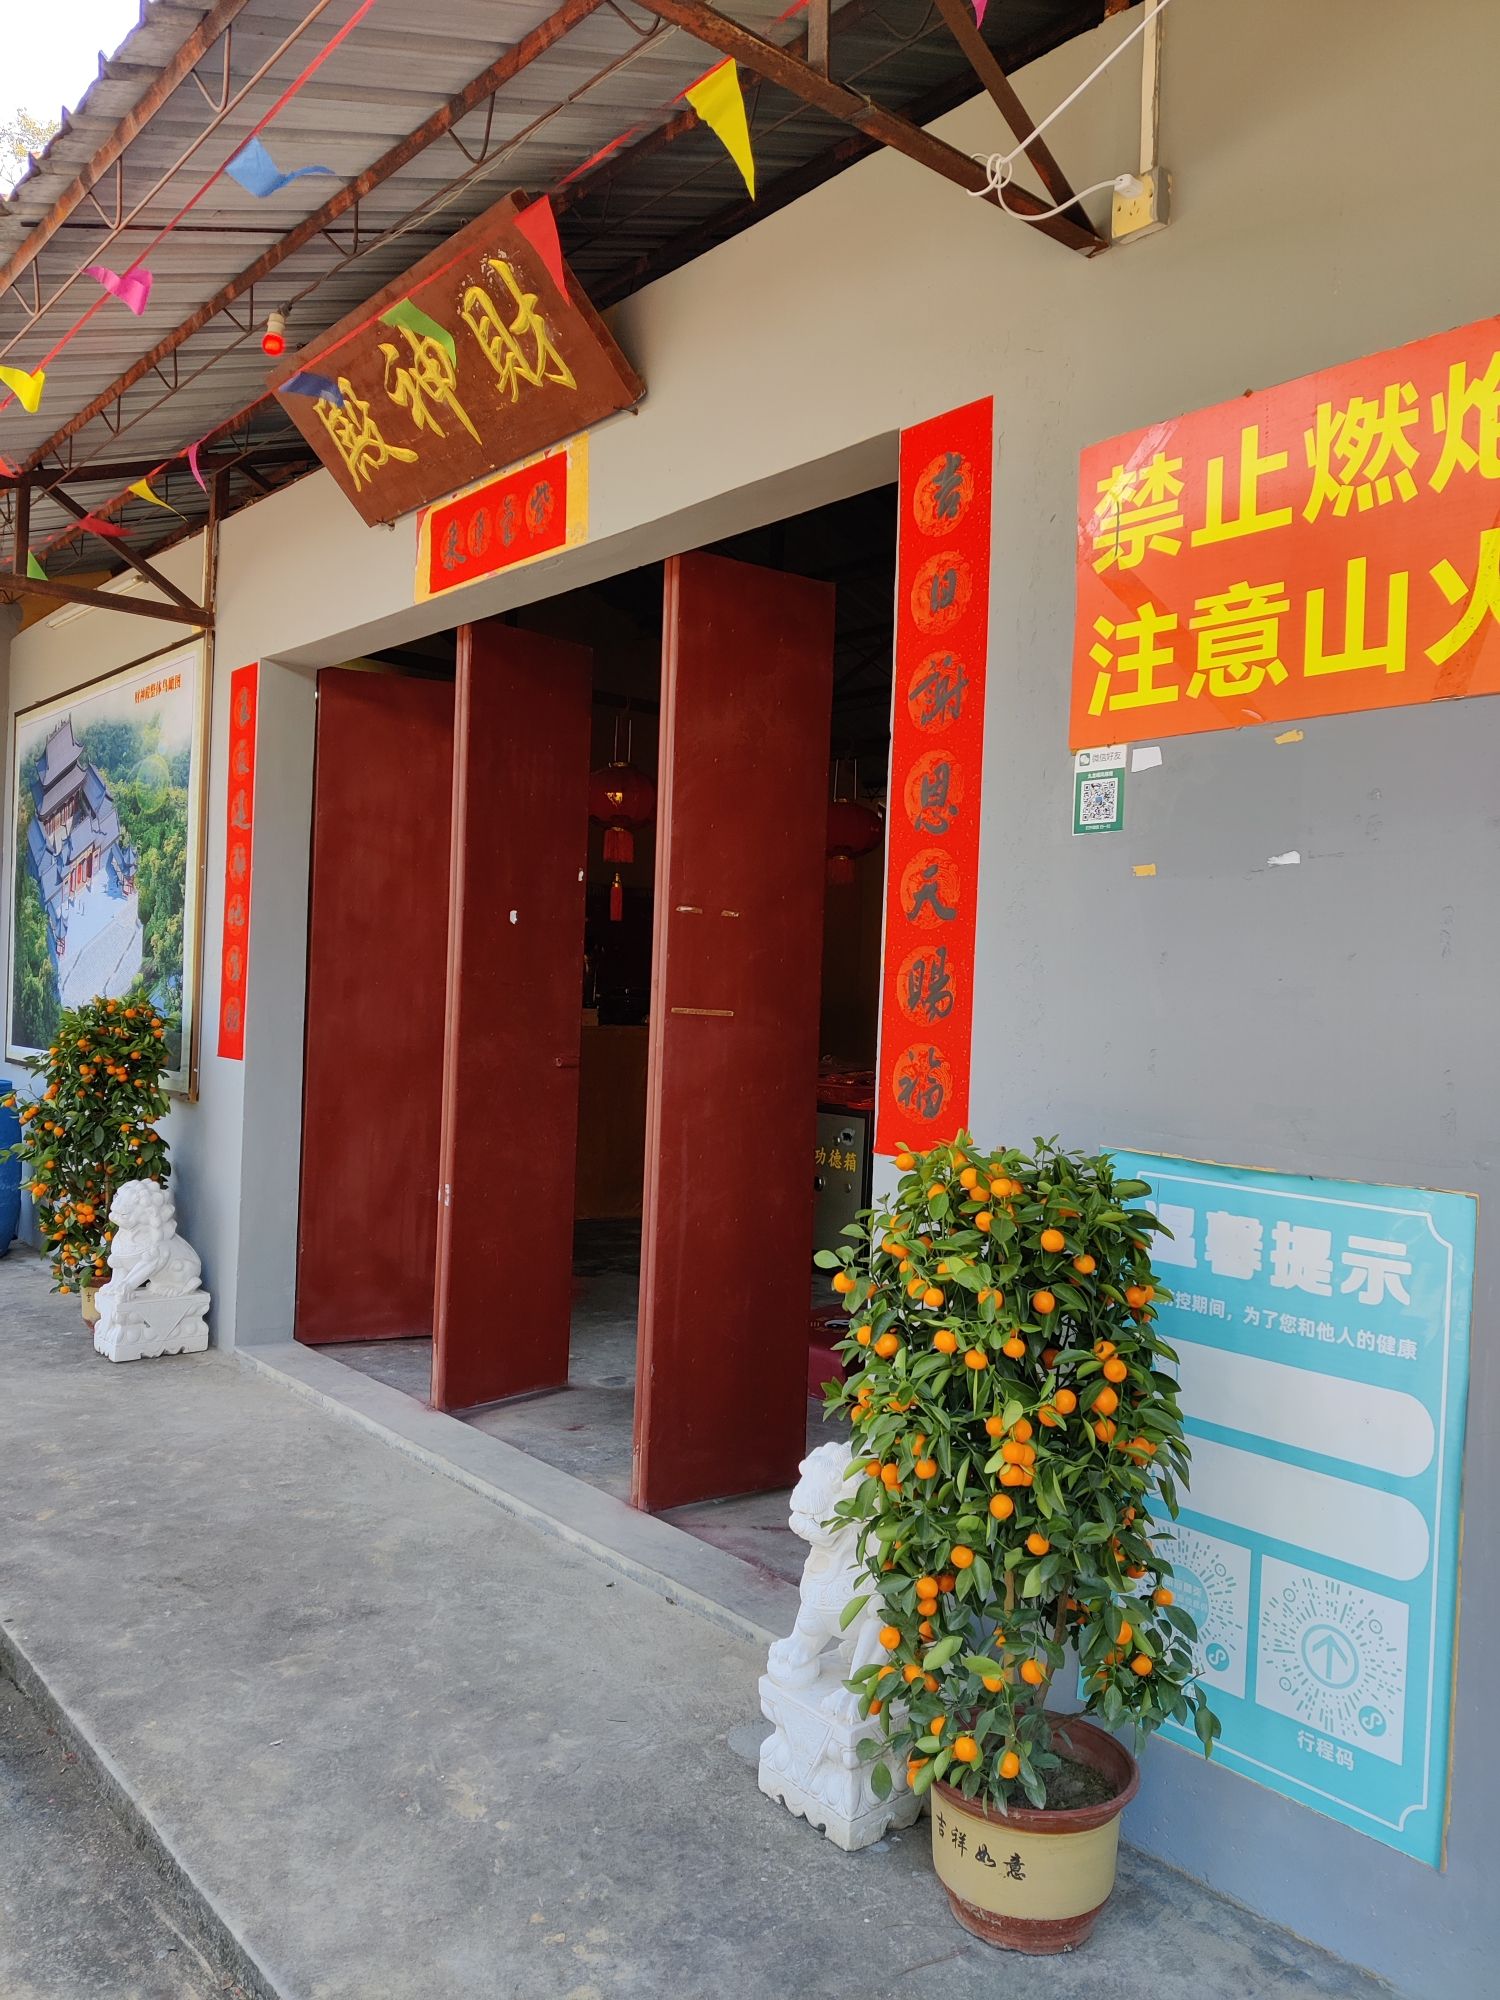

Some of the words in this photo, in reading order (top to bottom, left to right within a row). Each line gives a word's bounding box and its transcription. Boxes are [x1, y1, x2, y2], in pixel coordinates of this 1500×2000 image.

[815, 1147, 857, 1173] 功德箱
[1297, 1730, 1355, 1772] 行程码
